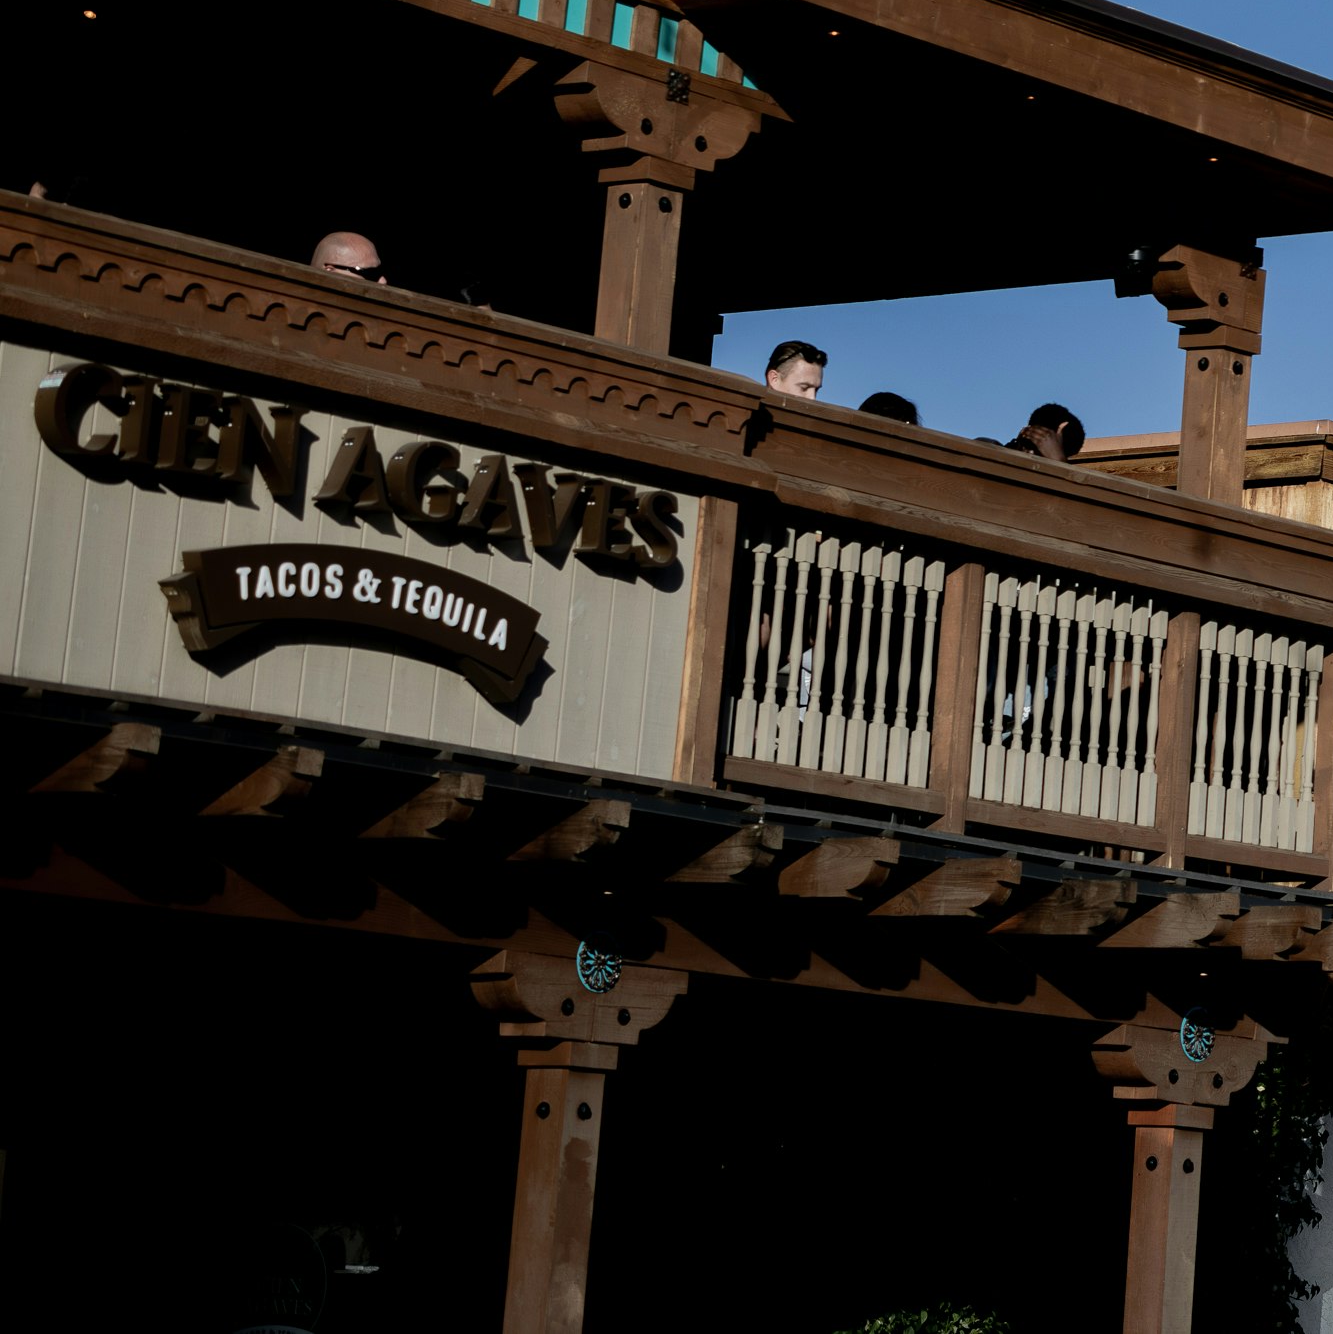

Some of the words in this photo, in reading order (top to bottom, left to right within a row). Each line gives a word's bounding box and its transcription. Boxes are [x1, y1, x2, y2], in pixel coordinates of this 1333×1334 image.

[33, 363, 312, 497] CIEN
[313, 425, 680, 568] AGAVES
[236, 561, 344, 602] TACOS
[353, 569, 382, 604] &
[391, 575, 510, 652] TEQUILA
